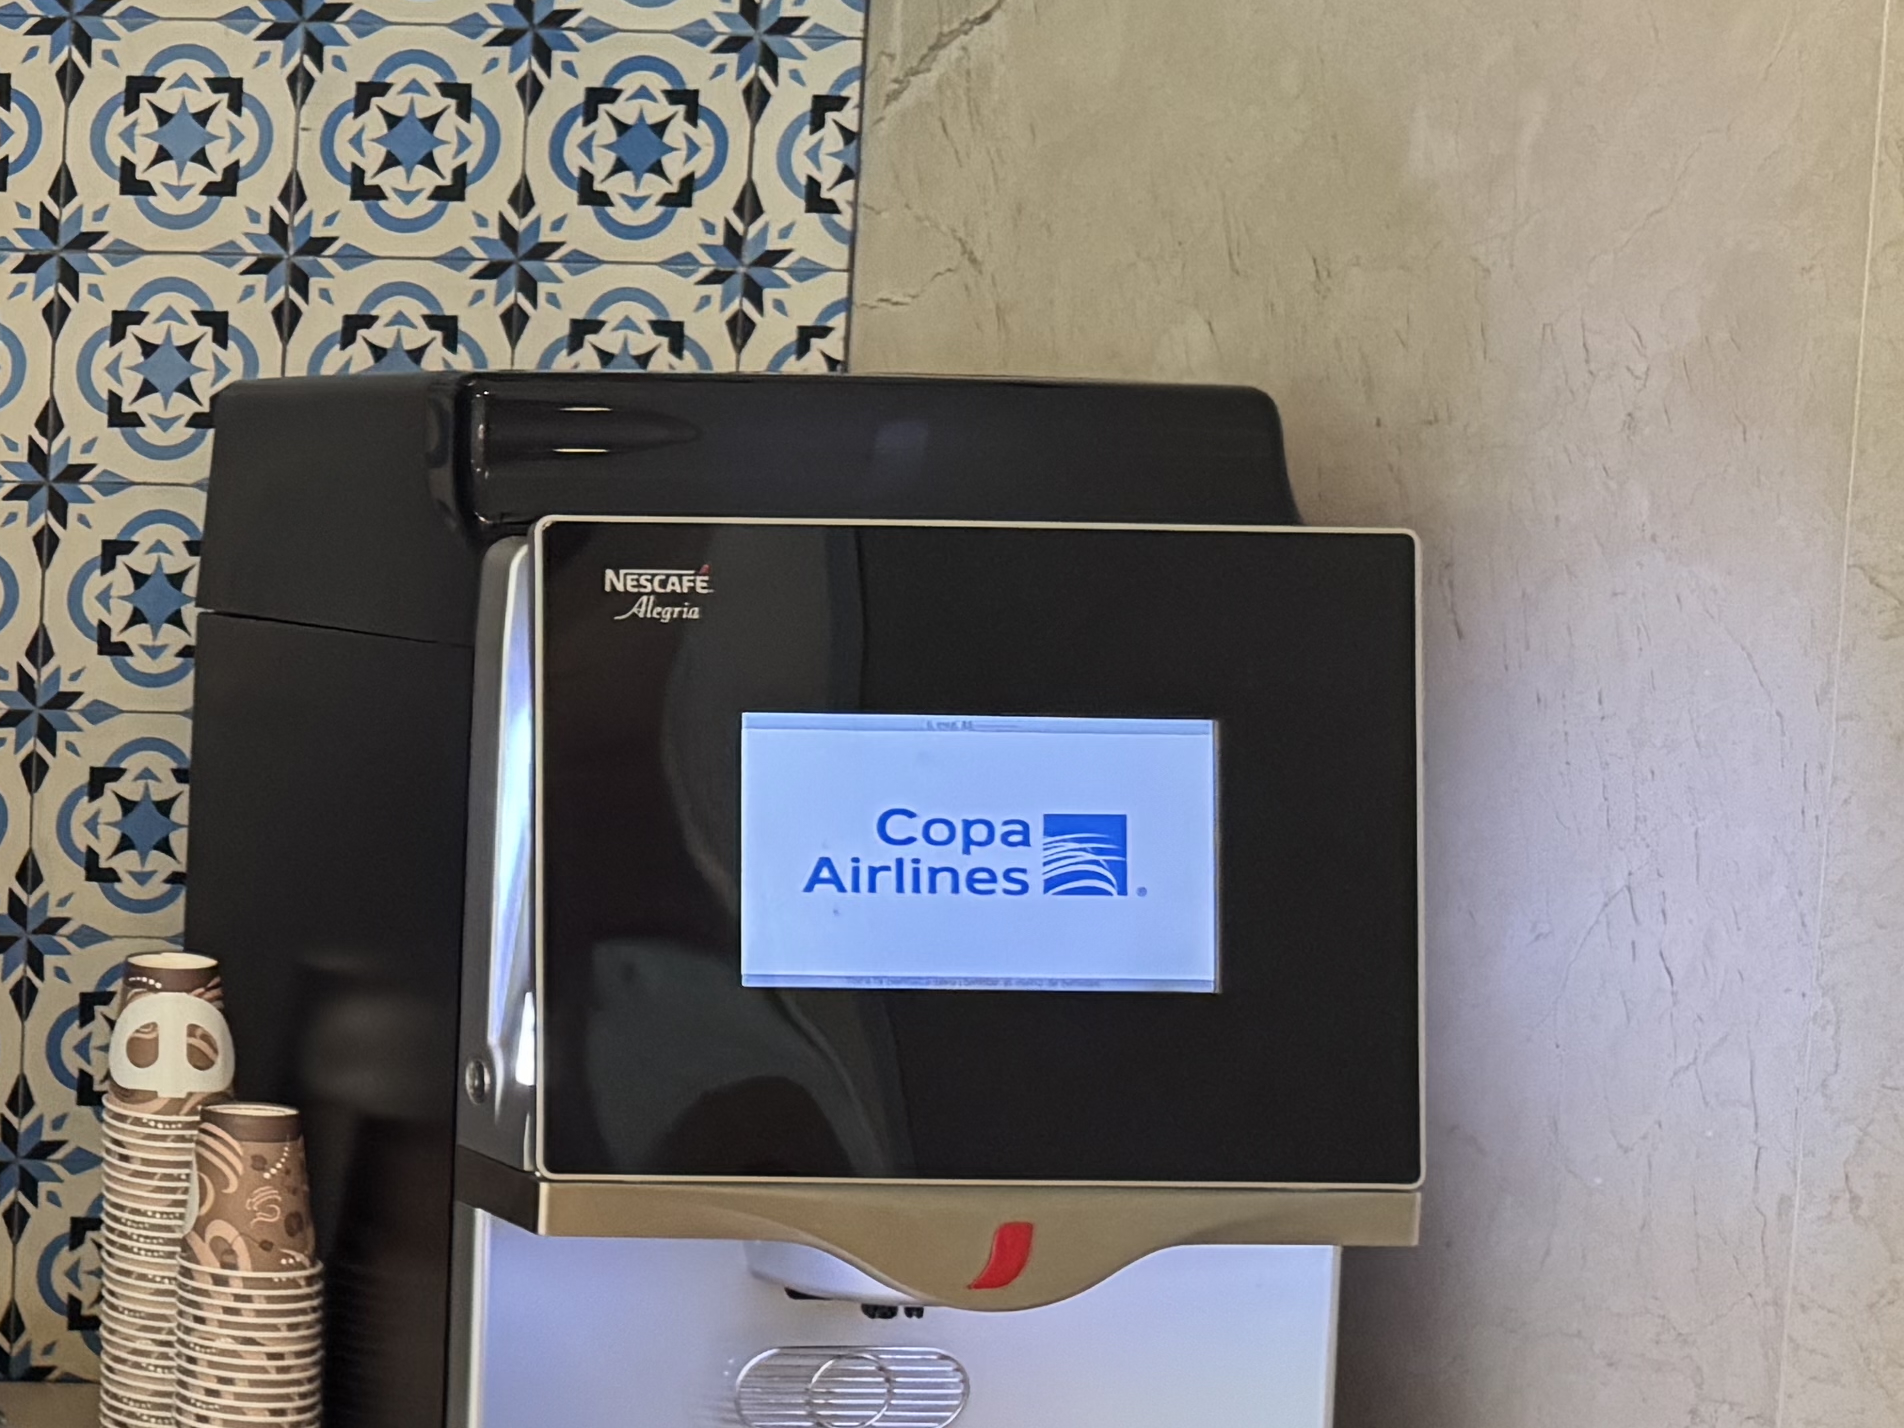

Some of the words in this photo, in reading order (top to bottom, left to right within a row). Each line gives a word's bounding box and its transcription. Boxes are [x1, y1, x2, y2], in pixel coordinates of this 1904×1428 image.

[613, 594, 701, 623] Alegria
[875, 808, 1032, 856] Copa
[802, 856, 1030, 897] Airlines
